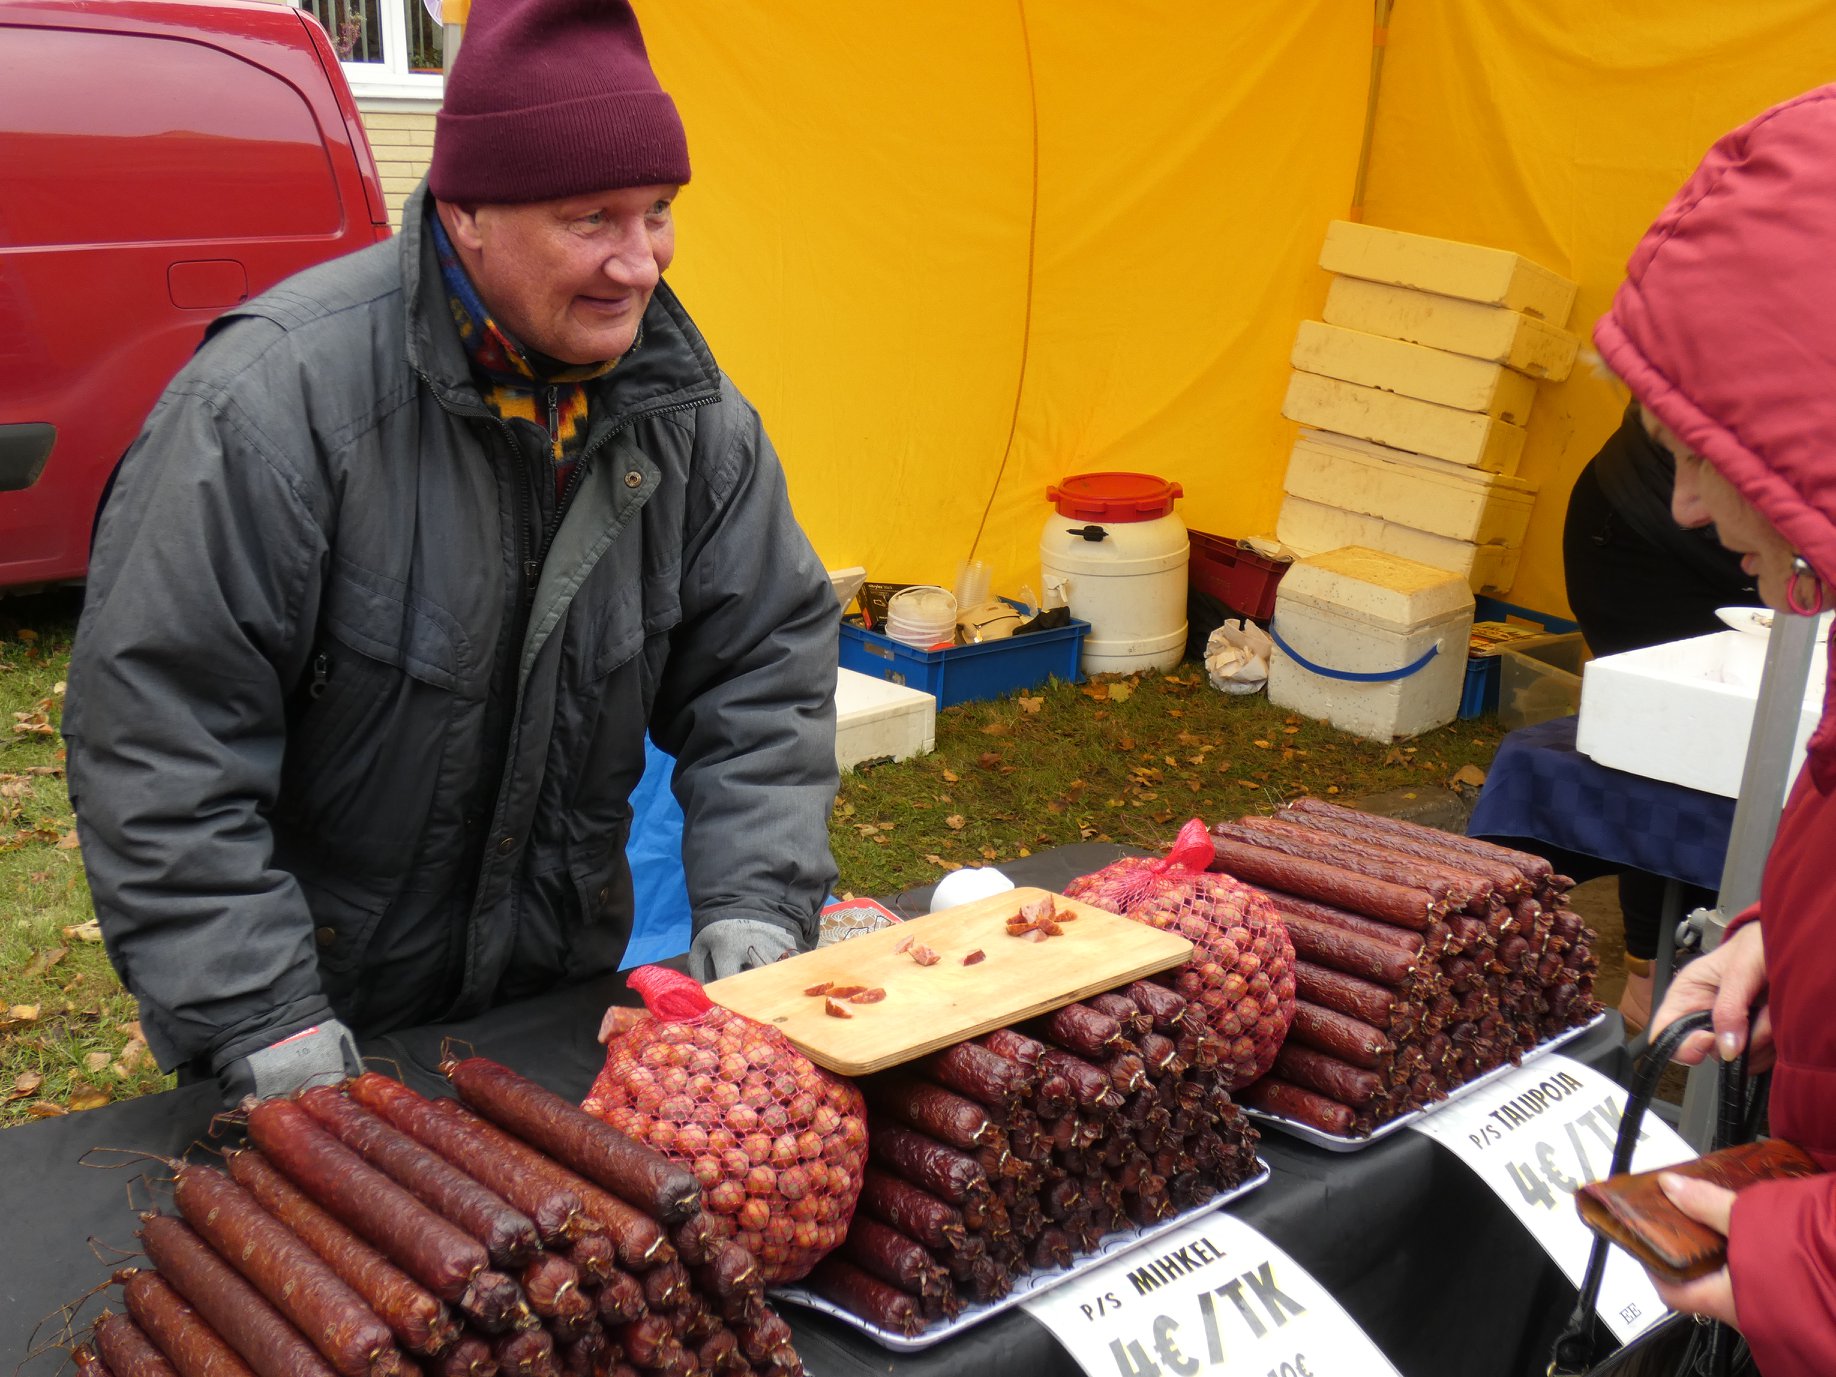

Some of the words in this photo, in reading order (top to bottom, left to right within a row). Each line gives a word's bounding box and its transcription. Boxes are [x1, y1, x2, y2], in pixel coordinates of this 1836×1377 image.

[1469, 1124, 1502, 1150] P/S
[1488, 1071, 1584, 1131] TALUPOJA
[1080, 1292, 1122, 1322] P/S
[1126, 1237, 1228, 1296] MIHKEL
[1619, 1302, 1642, 1325] EE
